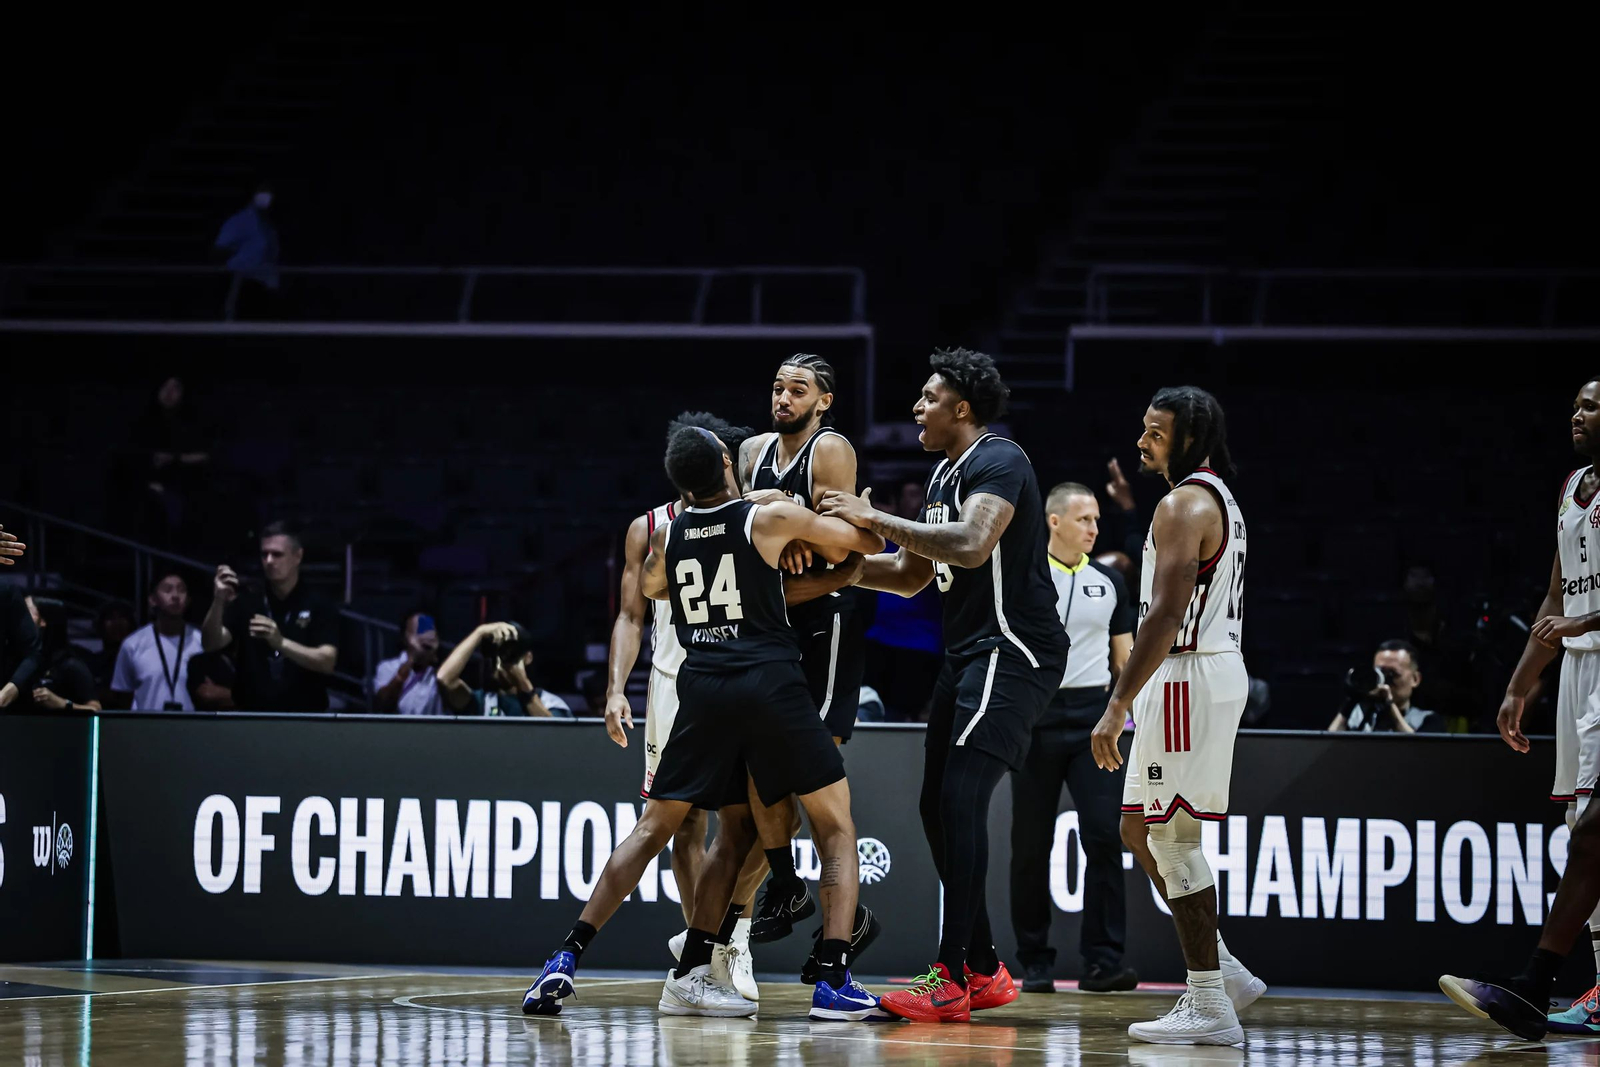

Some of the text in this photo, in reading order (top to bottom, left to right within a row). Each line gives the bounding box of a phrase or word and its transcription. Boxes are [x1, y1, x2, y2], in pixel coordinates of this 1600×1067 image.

[675, 553, 744, 625] 24
[691, 624, 740, 644] KINSEY
[193, 793, 281, 894] OF
